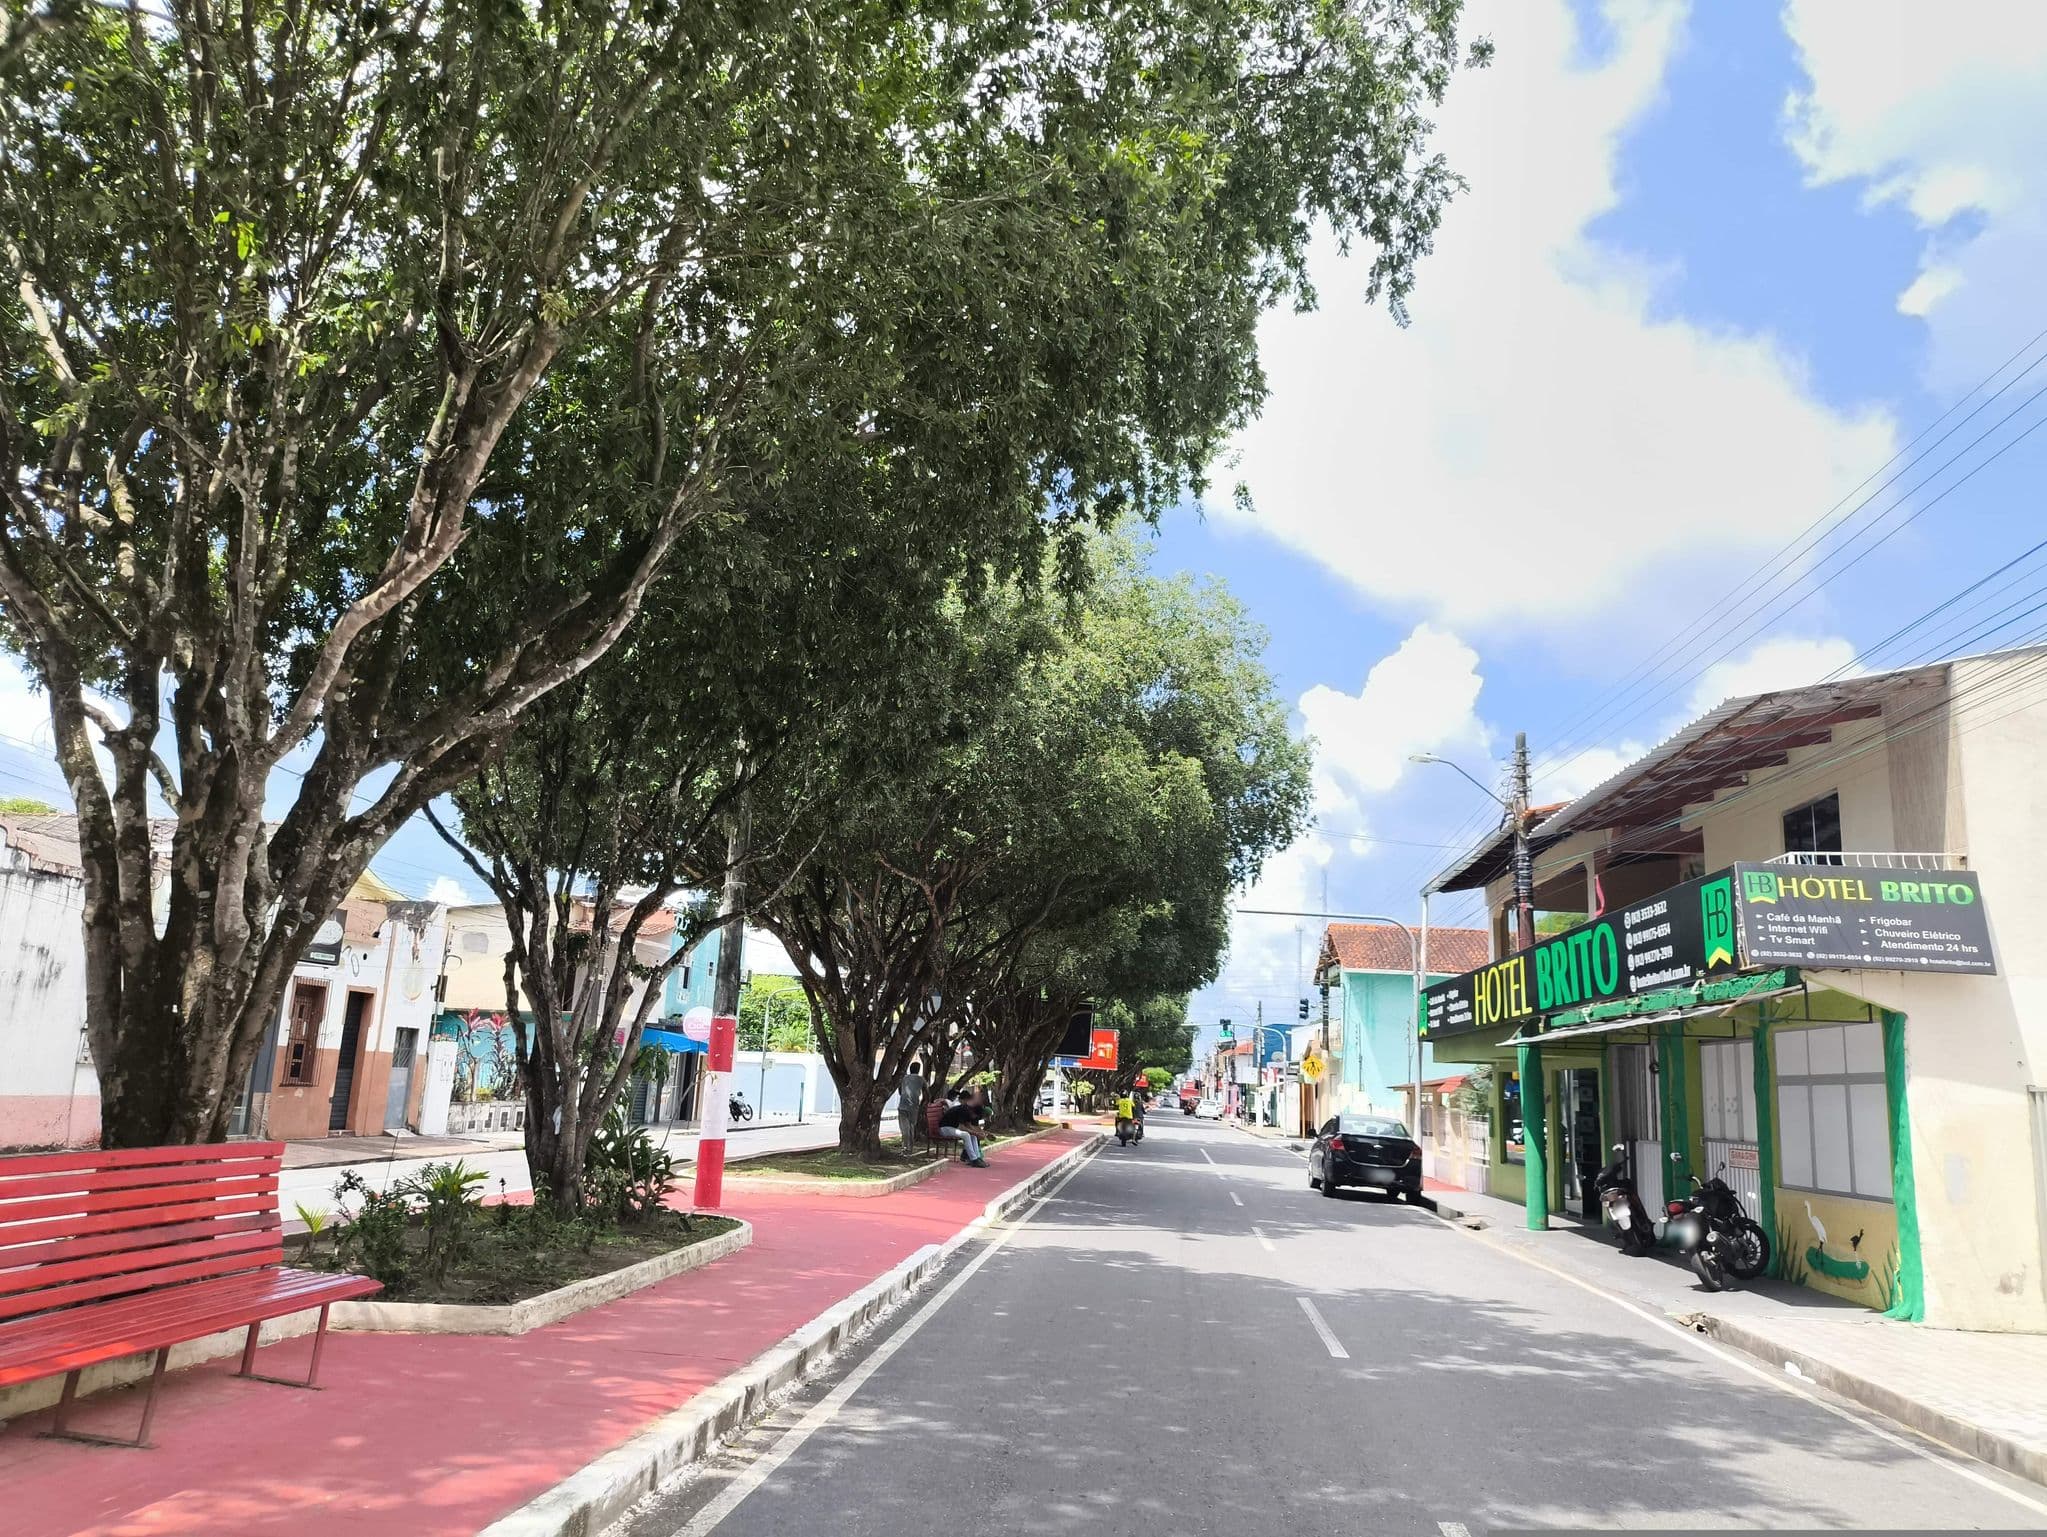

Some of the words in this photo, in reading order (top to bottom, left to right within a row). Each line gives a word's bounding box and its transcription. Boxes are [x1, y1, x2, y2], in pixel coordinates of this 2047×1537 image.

[1777, 877, 1872, 901] HOTEL
[1880, 881, 1974, 905] BRITO
[1767, 913, 1790, 922] Café
[1793, 914, 1805, 922] da
[1808, 915, 1841, 924] Manhã
[1870, 916, 1912, 927] Frigobar
[1768, 924, 1807, 934] Internet
[1809, 926, 1828, 934] Wifi
[1875, 928, 1920, 939] Chuveiro
[1922, 930, 1961, 941] Elétrico
[1769, 935, 1782, 943] Tv
[1785, 936, 1815, 945] Smart
[1880, 940, 1944, 951] Atendimento
[1946, 943, 1959, 952] 24
[1962, 944, 1978, 953] hrs
[1474, 956, 1532, 1026] HOTEL
[1535, 922, 1618, 1010] BRITO
